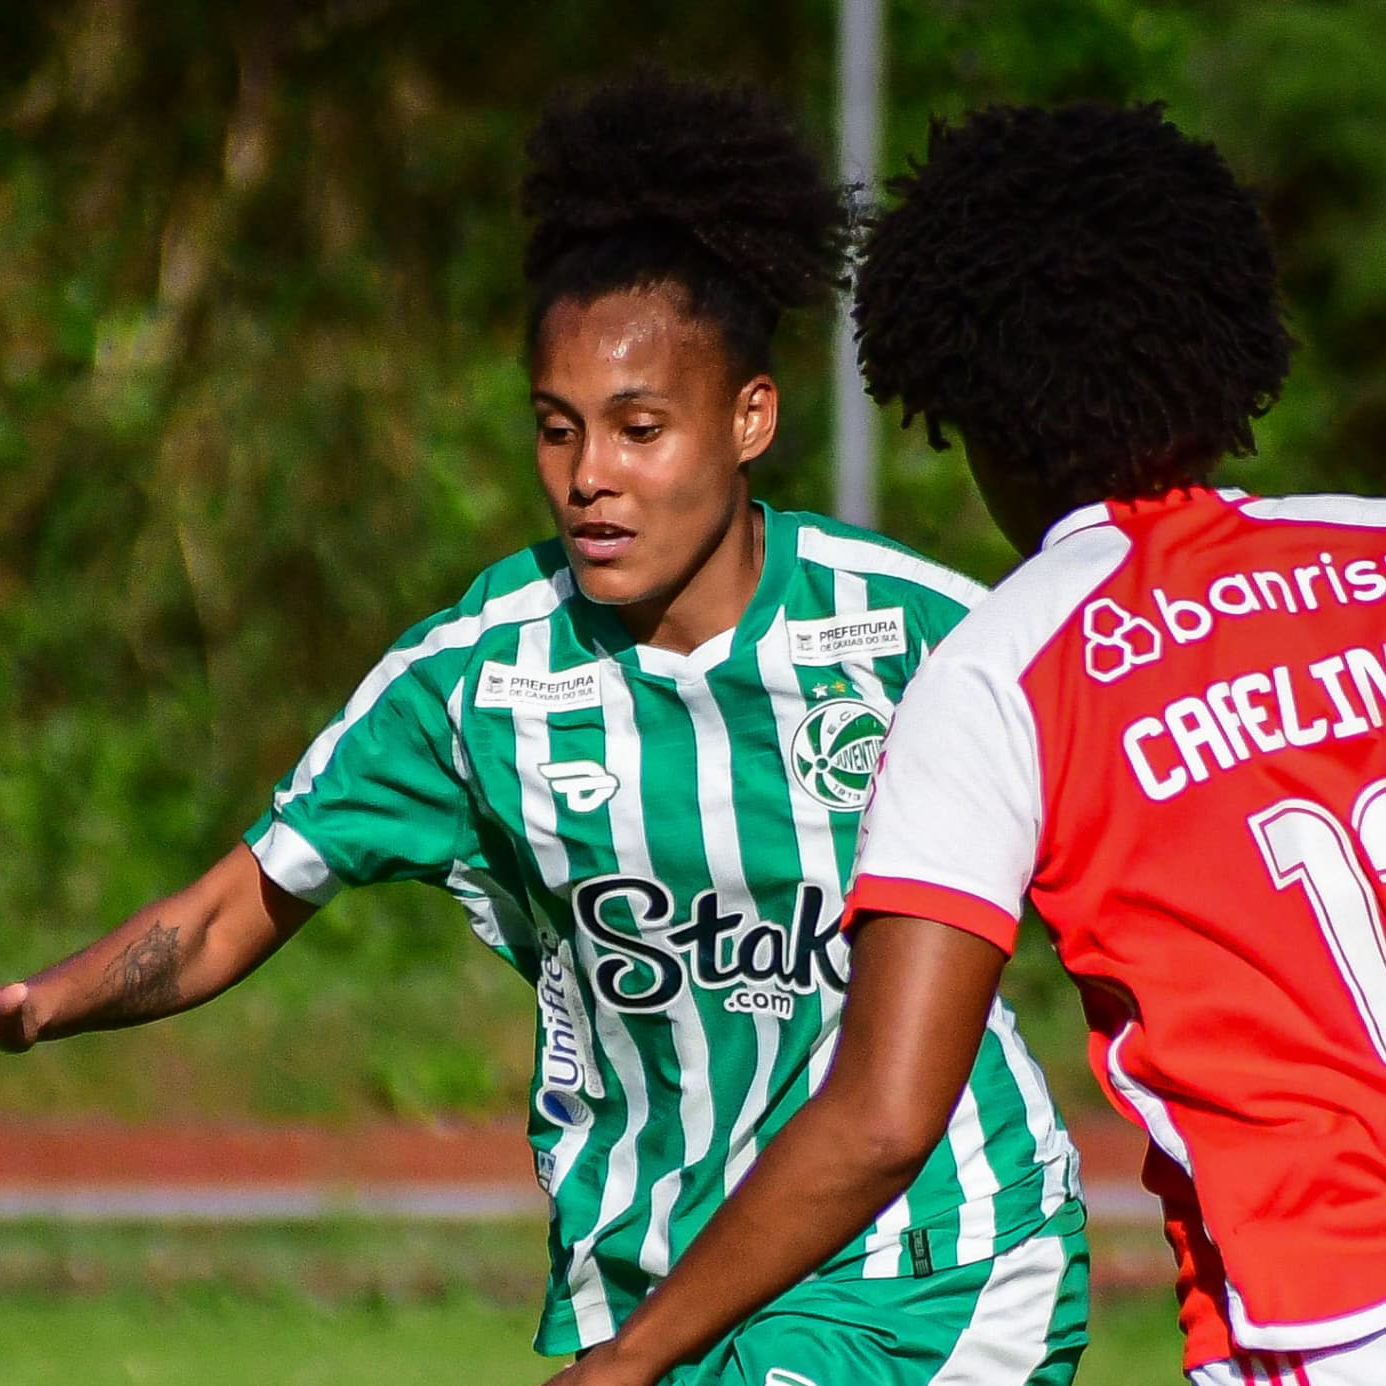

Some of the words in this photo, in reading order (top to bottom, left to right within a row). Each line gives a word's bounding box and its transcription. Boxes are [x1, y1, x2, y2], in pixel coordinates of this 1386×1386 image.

[819, 620, 898, 642] PREFEITURA
[509, 674, 595, 693] PREFEITURA
[835, 738, 884, 771] JUVENTU
[575, 877, 848, 1009] Stak
[727, 991, 792, 1016] .com
